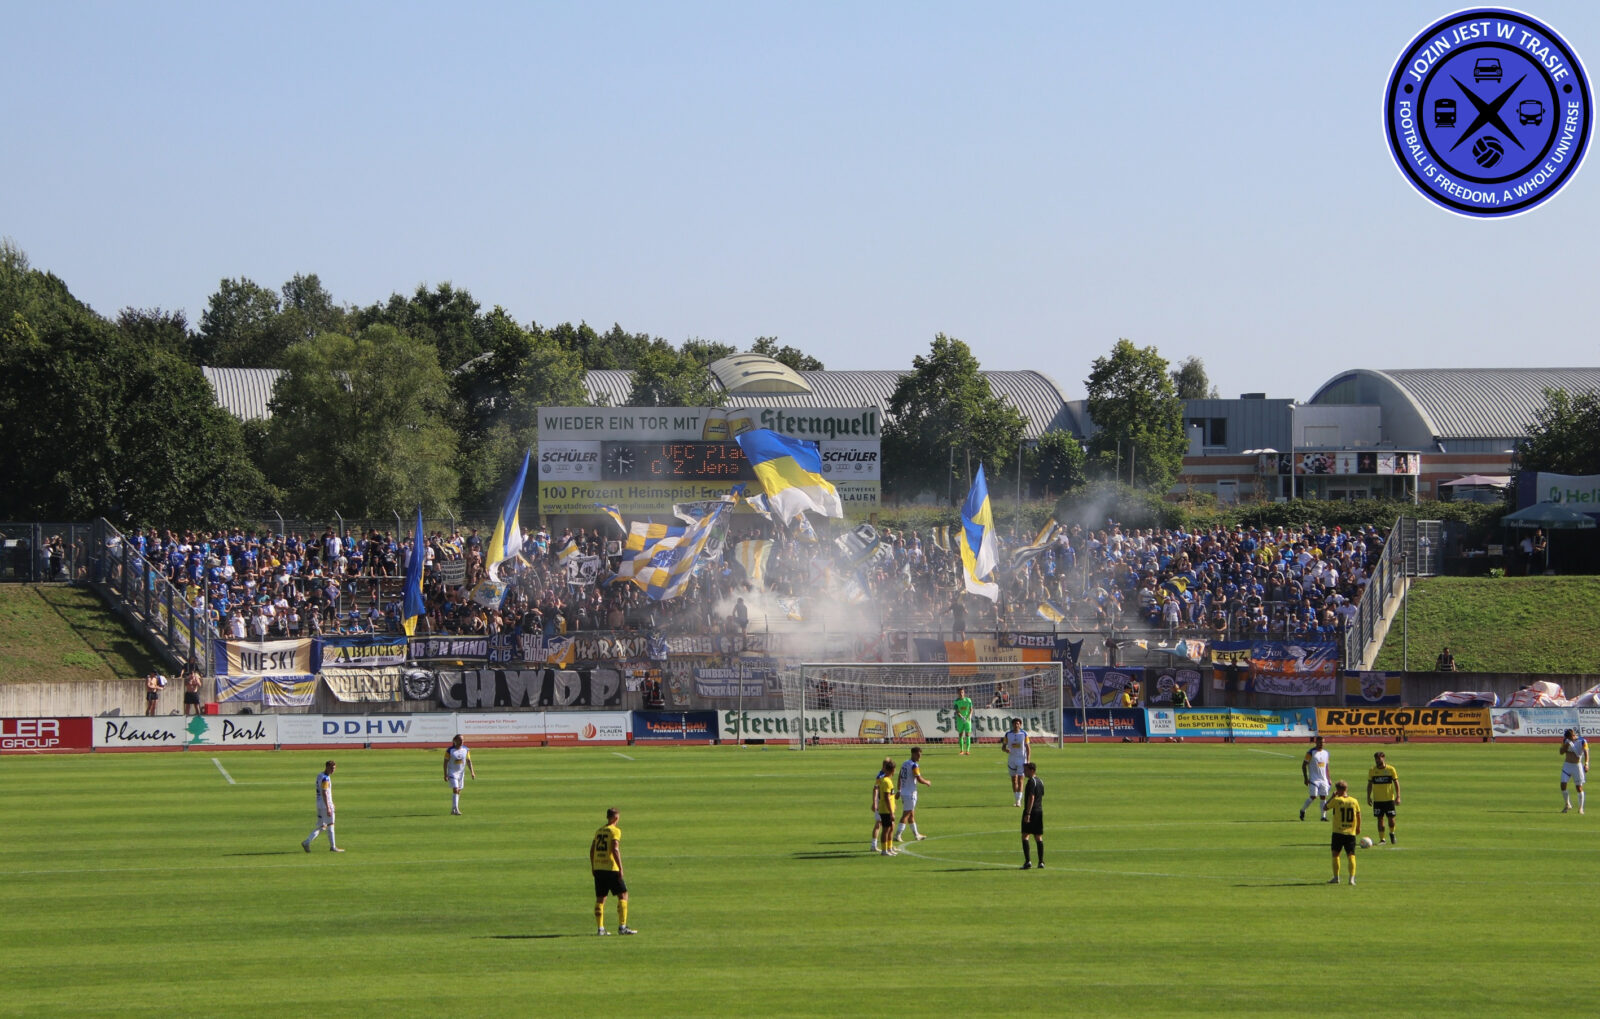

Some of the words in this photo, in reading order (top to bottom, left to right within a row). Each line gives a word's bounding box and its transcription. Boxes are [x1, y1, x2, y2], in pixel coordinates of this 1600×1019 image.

[544, 417, 604, 430] WIEDER
[610, 417, 634, 430] EIN
[639, 417, 668, 430] TOR
[674, 417, 699, 430] MIT
[760, 408, 876, 440] Sternquell
[542, 448, 598, 462] SCHÜLER
[663, 445, 694, 458] VFC
[822, 448, 877, 462] SCHÜLER
[542, 487, 567, 498] 100
[572, 486, 624, 498] Prozent
[1018, 635, 1055, 646] GERA
[352, 644, 394, 658] BLOCK
[451, 640, 488, 656] MIND
[576, 636, 650, 660] HARAKIR
[240, 650, 296, 671] NIESKY
[724, 709, 844, 735] Sternquell
[936, 708, 1058, 734] Srnquell
[1114, 718, 1134, 726] BAU
[1326, 709, 1452, 725] Rückoldt
[0, 720, 60, 737] LER
[105, 720, 176, 743] Plauen
[222, 720, 266, 742] Park
[322, 720, 412, 735] DDHW
[647, 722, 680, 730] LADEN
[2, 738, 60, 748] GROUP
[1340, 808, 1354, 822] 10
[596, 834, 608, 851] 25
